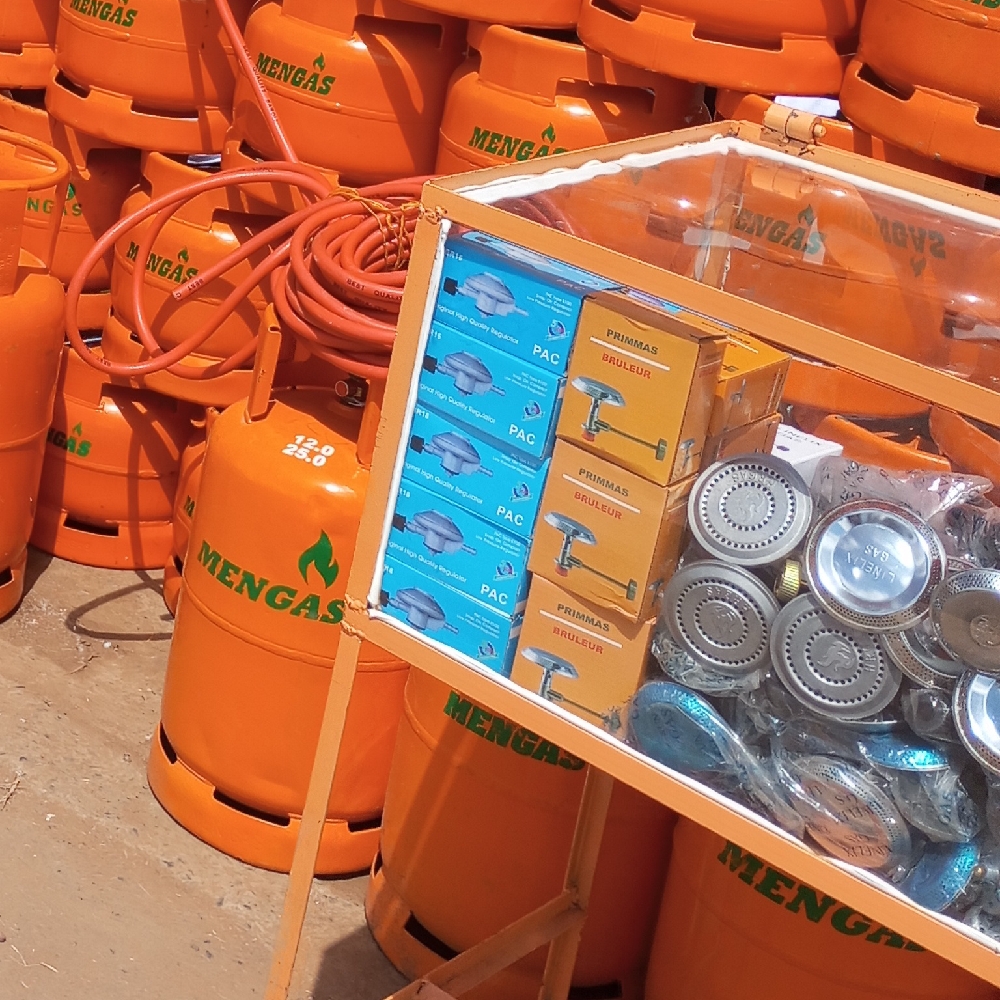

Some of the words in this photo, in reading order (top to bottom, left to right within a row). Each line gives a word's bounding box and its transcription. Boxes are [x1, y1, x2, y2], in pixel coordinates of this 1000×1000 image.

[255, 50, 336, 97] MENGAS
[126, 241, 199, 284] MNGAS
[346, 278, 365, 292] BEST
[532, 343, 560, 366] PAC
[606, 328, 659, 356] PRIMMAS
[601, 352, 652, 380] BRULEUR
[294, 434, 336, 458] 12.0
[508, 423, 536, 446] PAC
[281, 443, 328, 468] 25.0
[578, 467, 630, 499] PRIMMAS
[496, 505, 524, 526] PAC
[573, 490, 623, 521] BRULEUR
[197, 539, 346, 625] MENGAS
[480, 583, 509, 605] PAC
[557, 603, 611, 633] PRIMMAS
[552, 625, 605, 655] BRULEUR
[444, 690, 587, 772] MENGAS
[717, 839, 928, 952] MENGA
